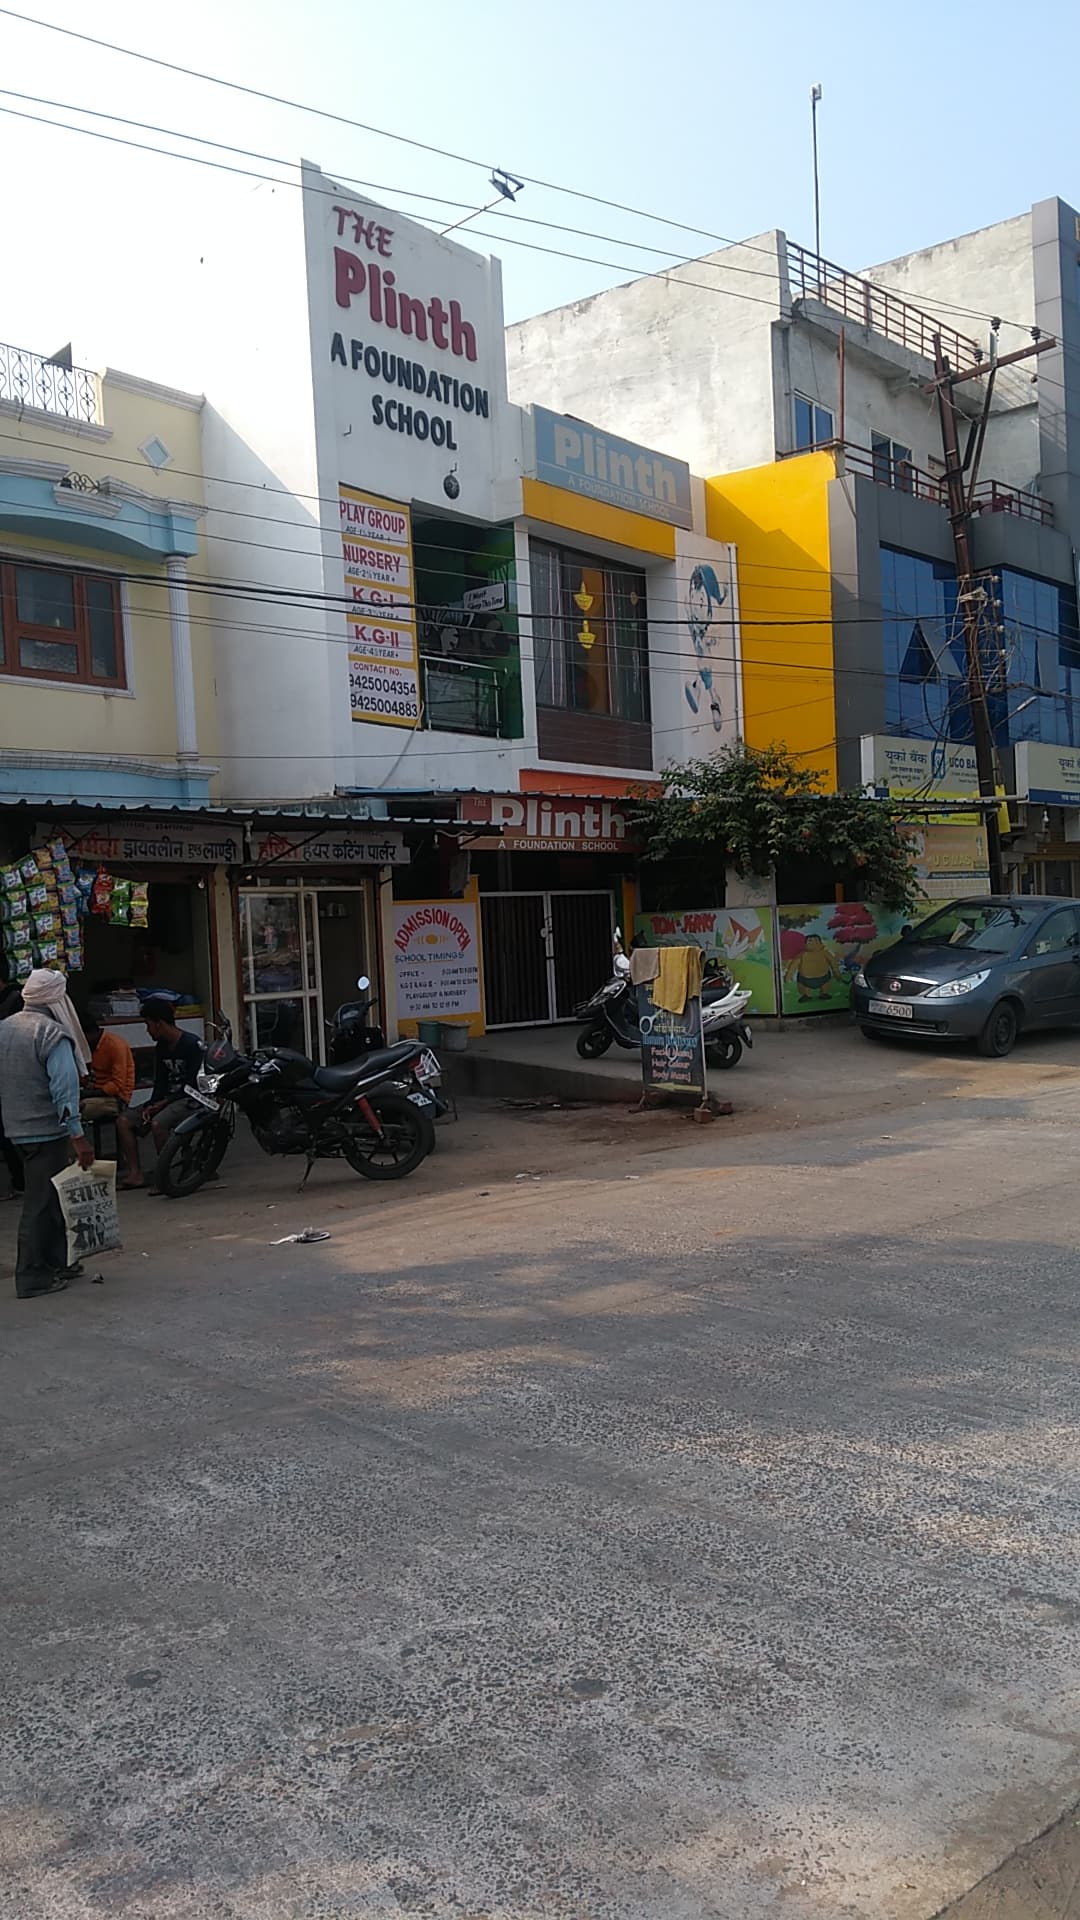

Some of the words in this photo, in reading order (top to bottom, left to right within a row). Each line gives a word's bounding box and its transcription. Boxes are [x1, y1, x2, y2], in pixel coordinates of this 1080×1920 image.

[333, 205, 394, 257] THE
[334, 246, 477, 362] Plinth
[331, 332, 347, 367] A
[351, 338, 489, 418] FOUNDATION
[372, 394, 457, 450] SCHOOL
[554, 424, 676, 504] Plinth
[568, 474, 576, 486] A
[340, 501, 366, 525] PLAY
[368, 509, 405, 535] GROUP
[343, 543, 401, 575] NURSERY
[349, 674, 417, 695] 9425004354
[353, 662, 387, 673] CONTACT
[389, 666, 402, 676] NO.
[350, 694, 418, 717] 9425004883
[949, 757, 965, 768] UCO
[966, 758, 977, 769] BA
[491, 797, 625, 838] Plinth
[332, 840, 364, 860] कटिंग
[367, 841, 397, 860] पार्लर
[498, 840, 506, 849] A
[513, 840, 575, 850] FOUNDATION
[582, 842, 619, 850] SCHOOL
[394, 908, 450, 953] ADMISSION
[449, 917, 471, 951] OPEN
[395, 953, 426, 963] SCHOOL
[428, 951, 464, 961] TIMINGS
